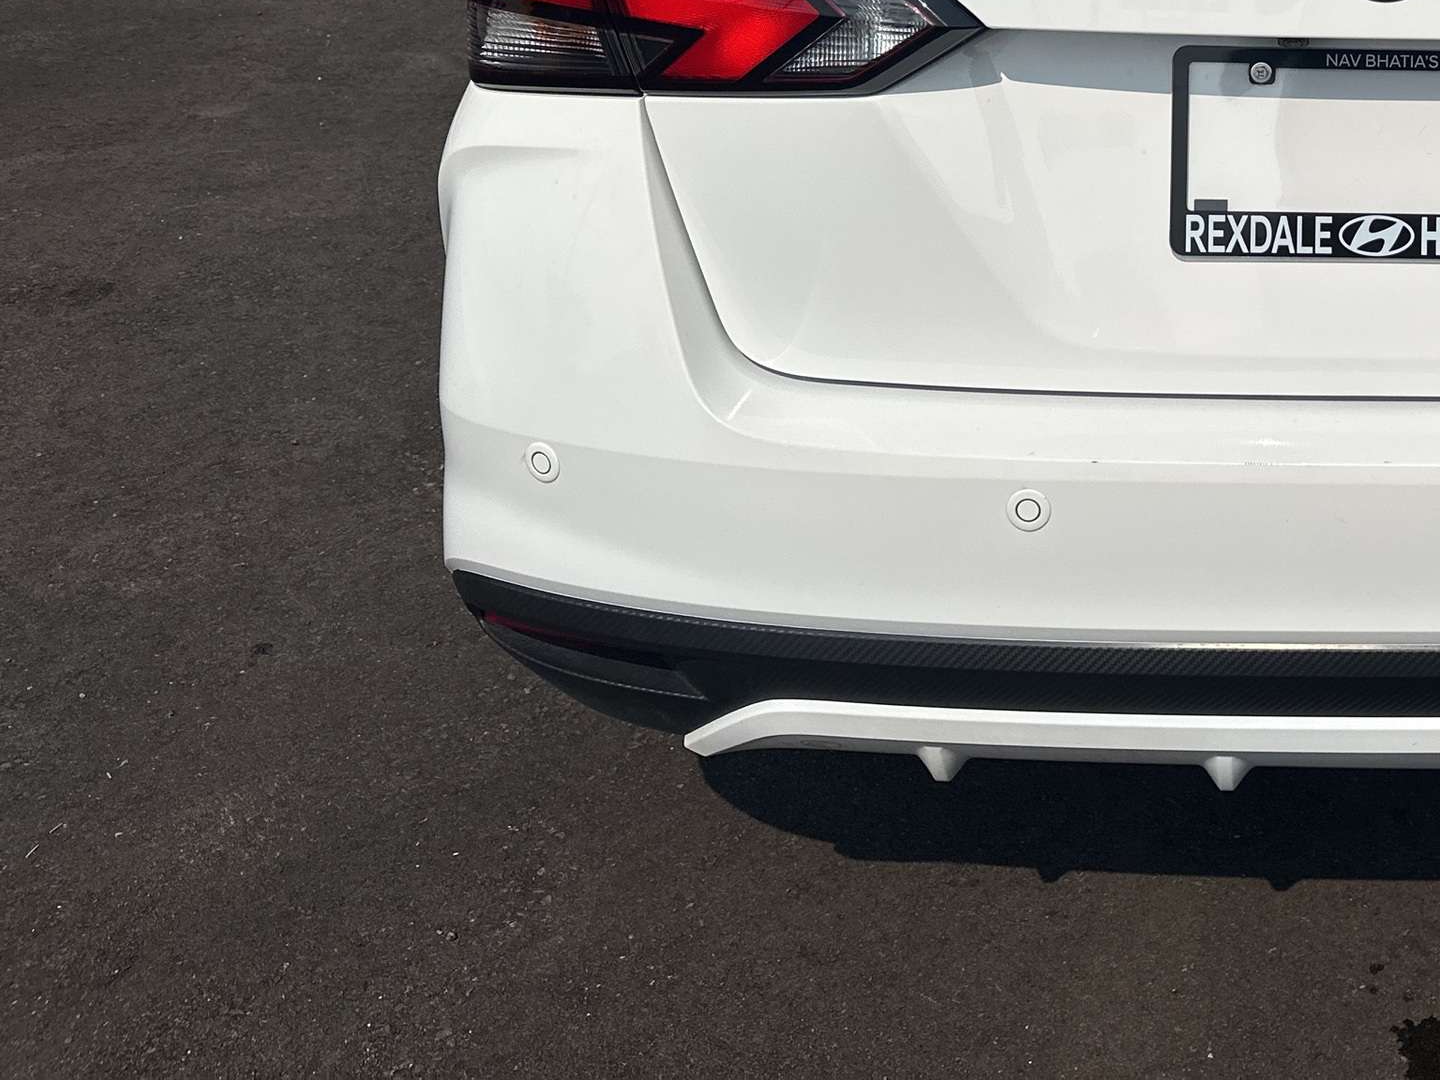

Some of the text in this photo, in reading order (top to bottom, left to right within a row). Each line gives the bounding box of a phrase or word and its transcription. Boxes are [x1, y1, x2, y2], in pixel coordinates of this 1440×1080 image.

[1326, 53, 1439, 69] NAV BHATIA'S
[1184, 214, 1332, 255] REXDALE
